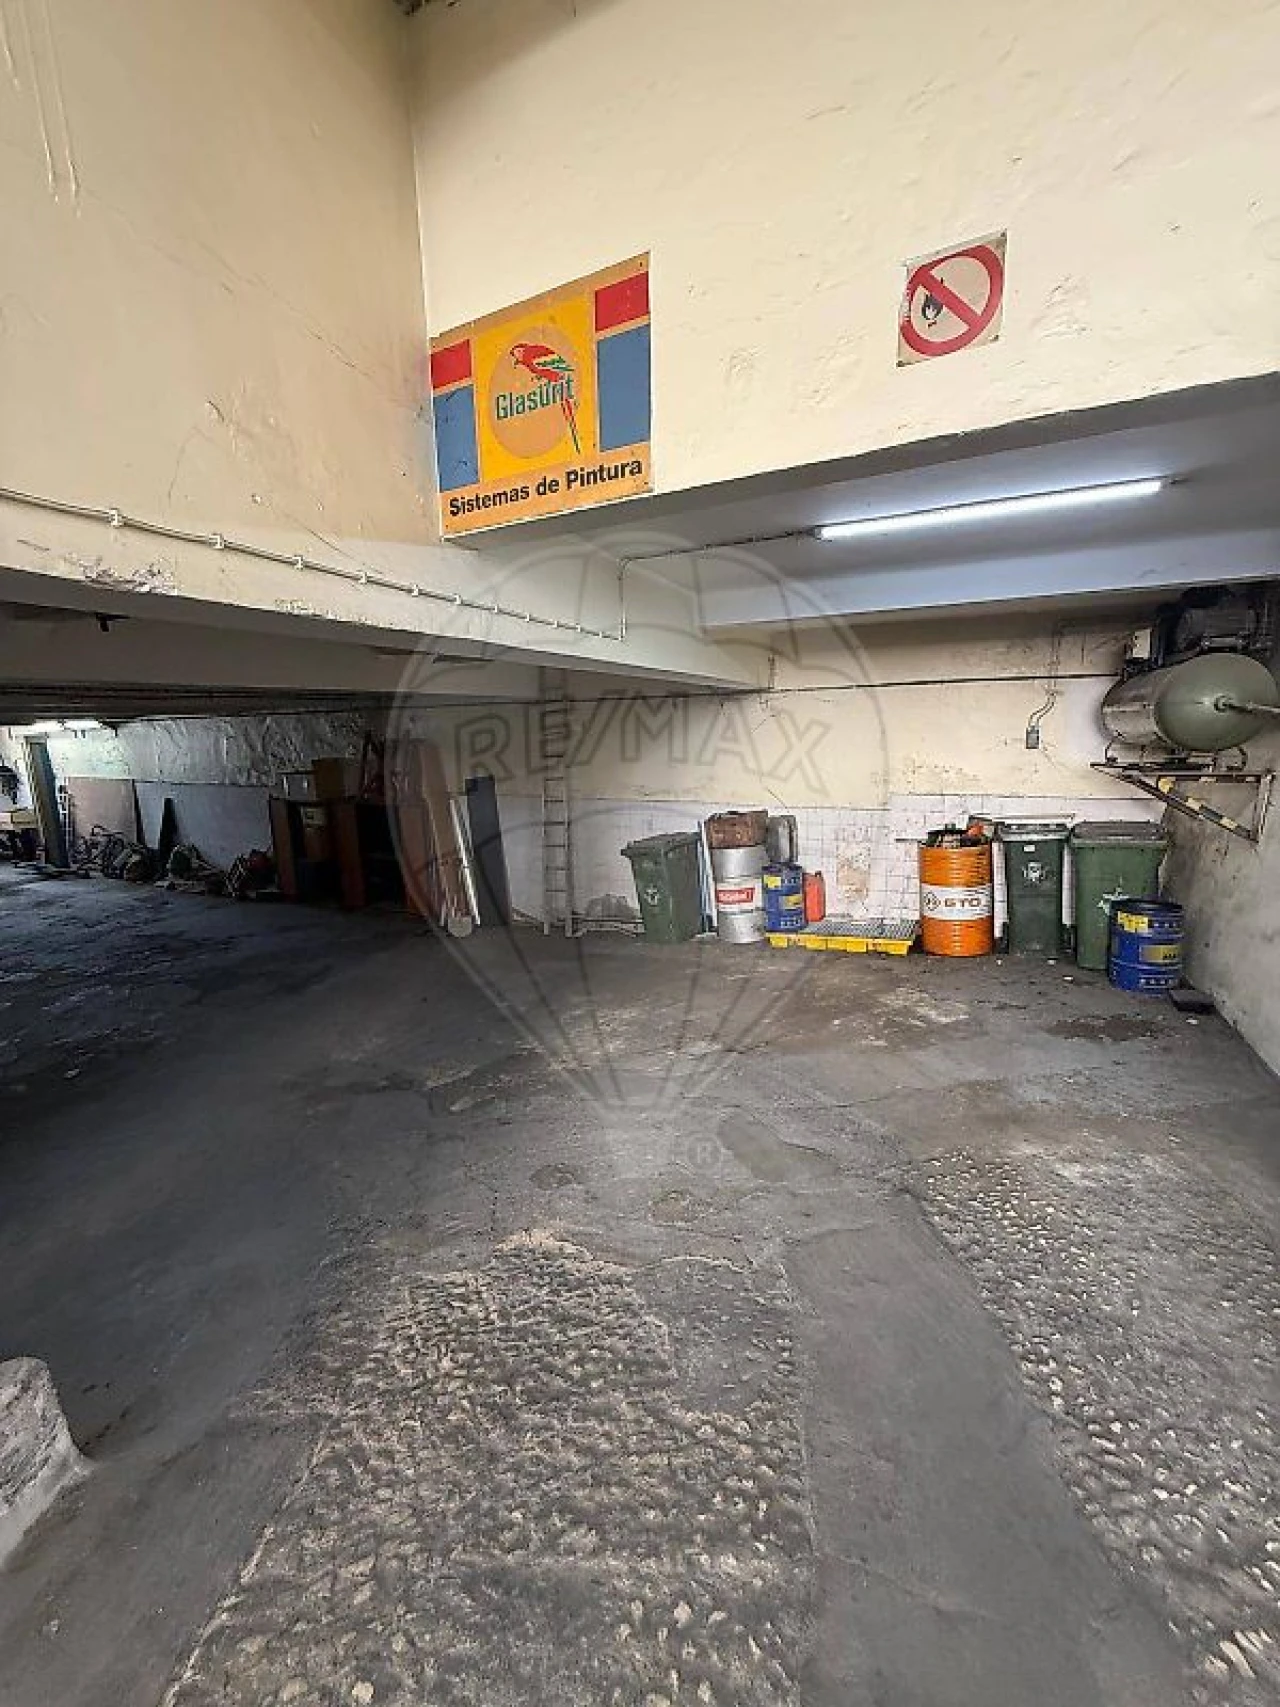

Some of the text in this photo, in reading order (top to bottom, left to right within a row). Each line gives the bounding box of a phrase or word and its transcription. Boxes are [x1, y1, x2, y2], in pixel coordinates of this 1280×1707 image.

[449, 459, 642, 516] Sistemas de Pintura
